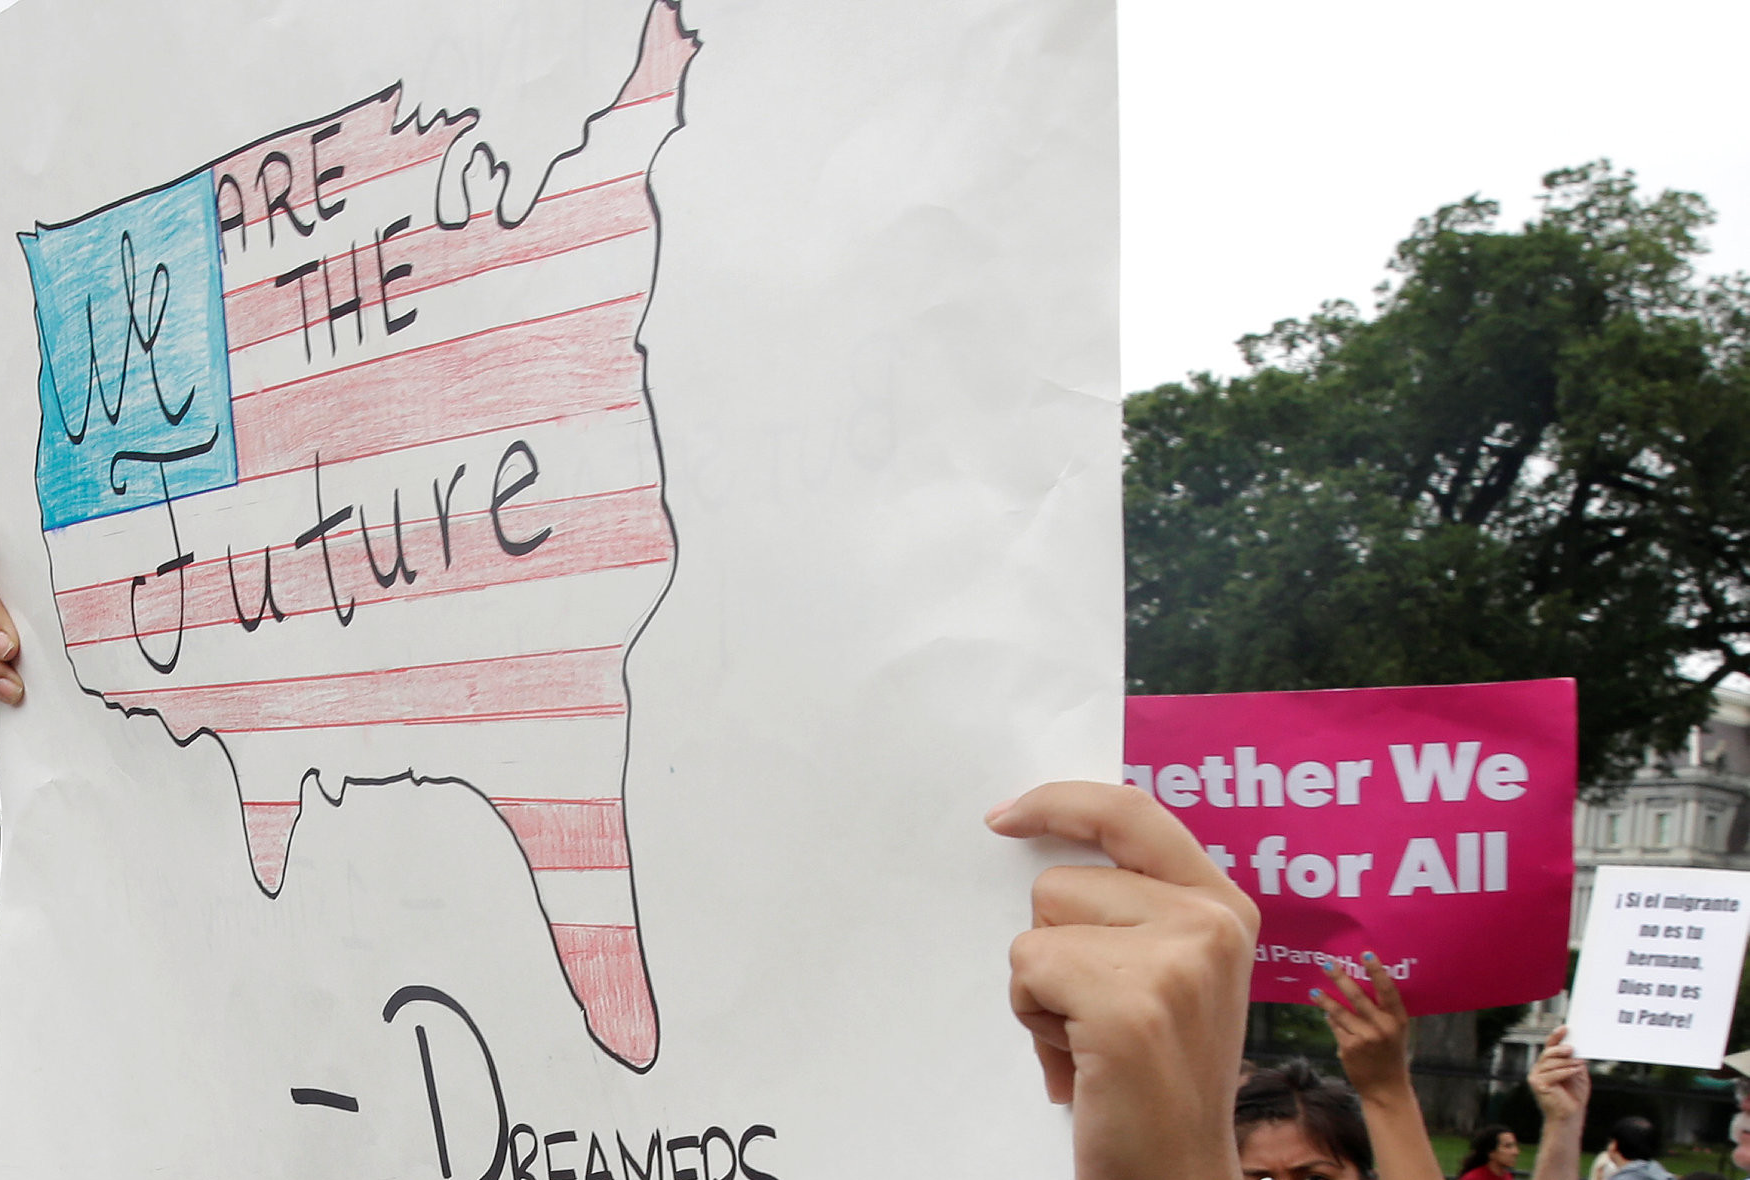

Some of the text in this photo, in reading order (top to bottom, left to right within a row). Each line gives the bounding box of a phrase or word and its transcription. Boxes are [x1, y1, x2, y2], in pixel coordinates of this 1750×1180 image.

[216, 123, 348, 265] ARE
[275, 215, 418, 364] THE
[38, 230, 196, 444] We
[110, 423, 552, 674] Future
[1123, 741, 1529, 808] ether We
[1250, 836, 1373, 898] for
[1388, 831, 1508, 896] All
[1639, 924, 1658, 937] no
[1663, 925, 1682, 938] es
[1645, 893, 1660, 908] el
[1662, 894, 1740, 912] migrante
[1617, 978, 1702, 999] Dios no es
[1617, 1009, 1693, 1029] tu Padre!
